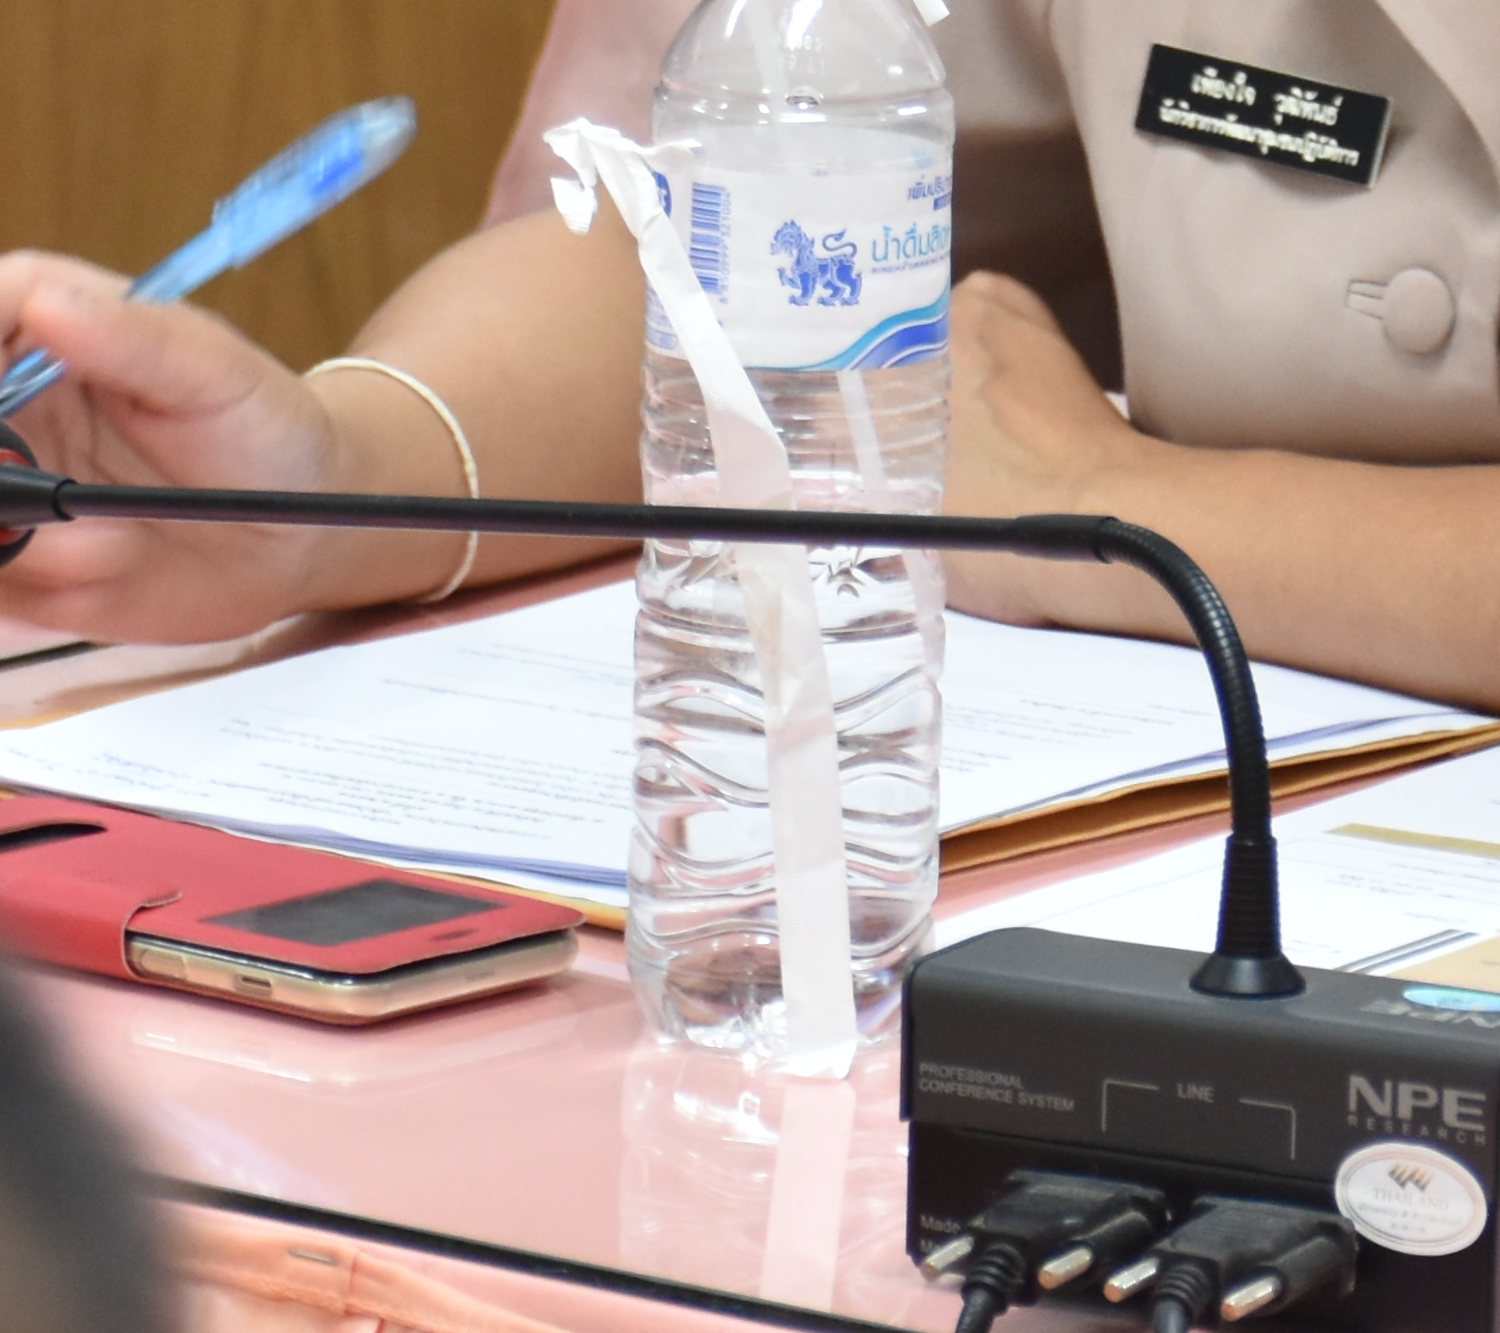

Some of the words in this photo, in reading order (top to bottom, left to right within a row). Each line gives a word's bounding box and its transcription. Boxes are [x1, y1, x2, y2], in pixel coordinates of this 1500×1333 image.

[919, 1062, 1023, 1090] PROFESSIONAL
[919, 1078, 1012, 1104] CONFERENCE
[1018, 1093, 1075, 1112] SYSTEM
[1177, 1083, 1214, 1103] LINE
[1349, 1074, 1487, 1132] NPE
[1347, 1114, 1486, 1146] RESEARCH
[919, 1214, 960, 1234] Made
